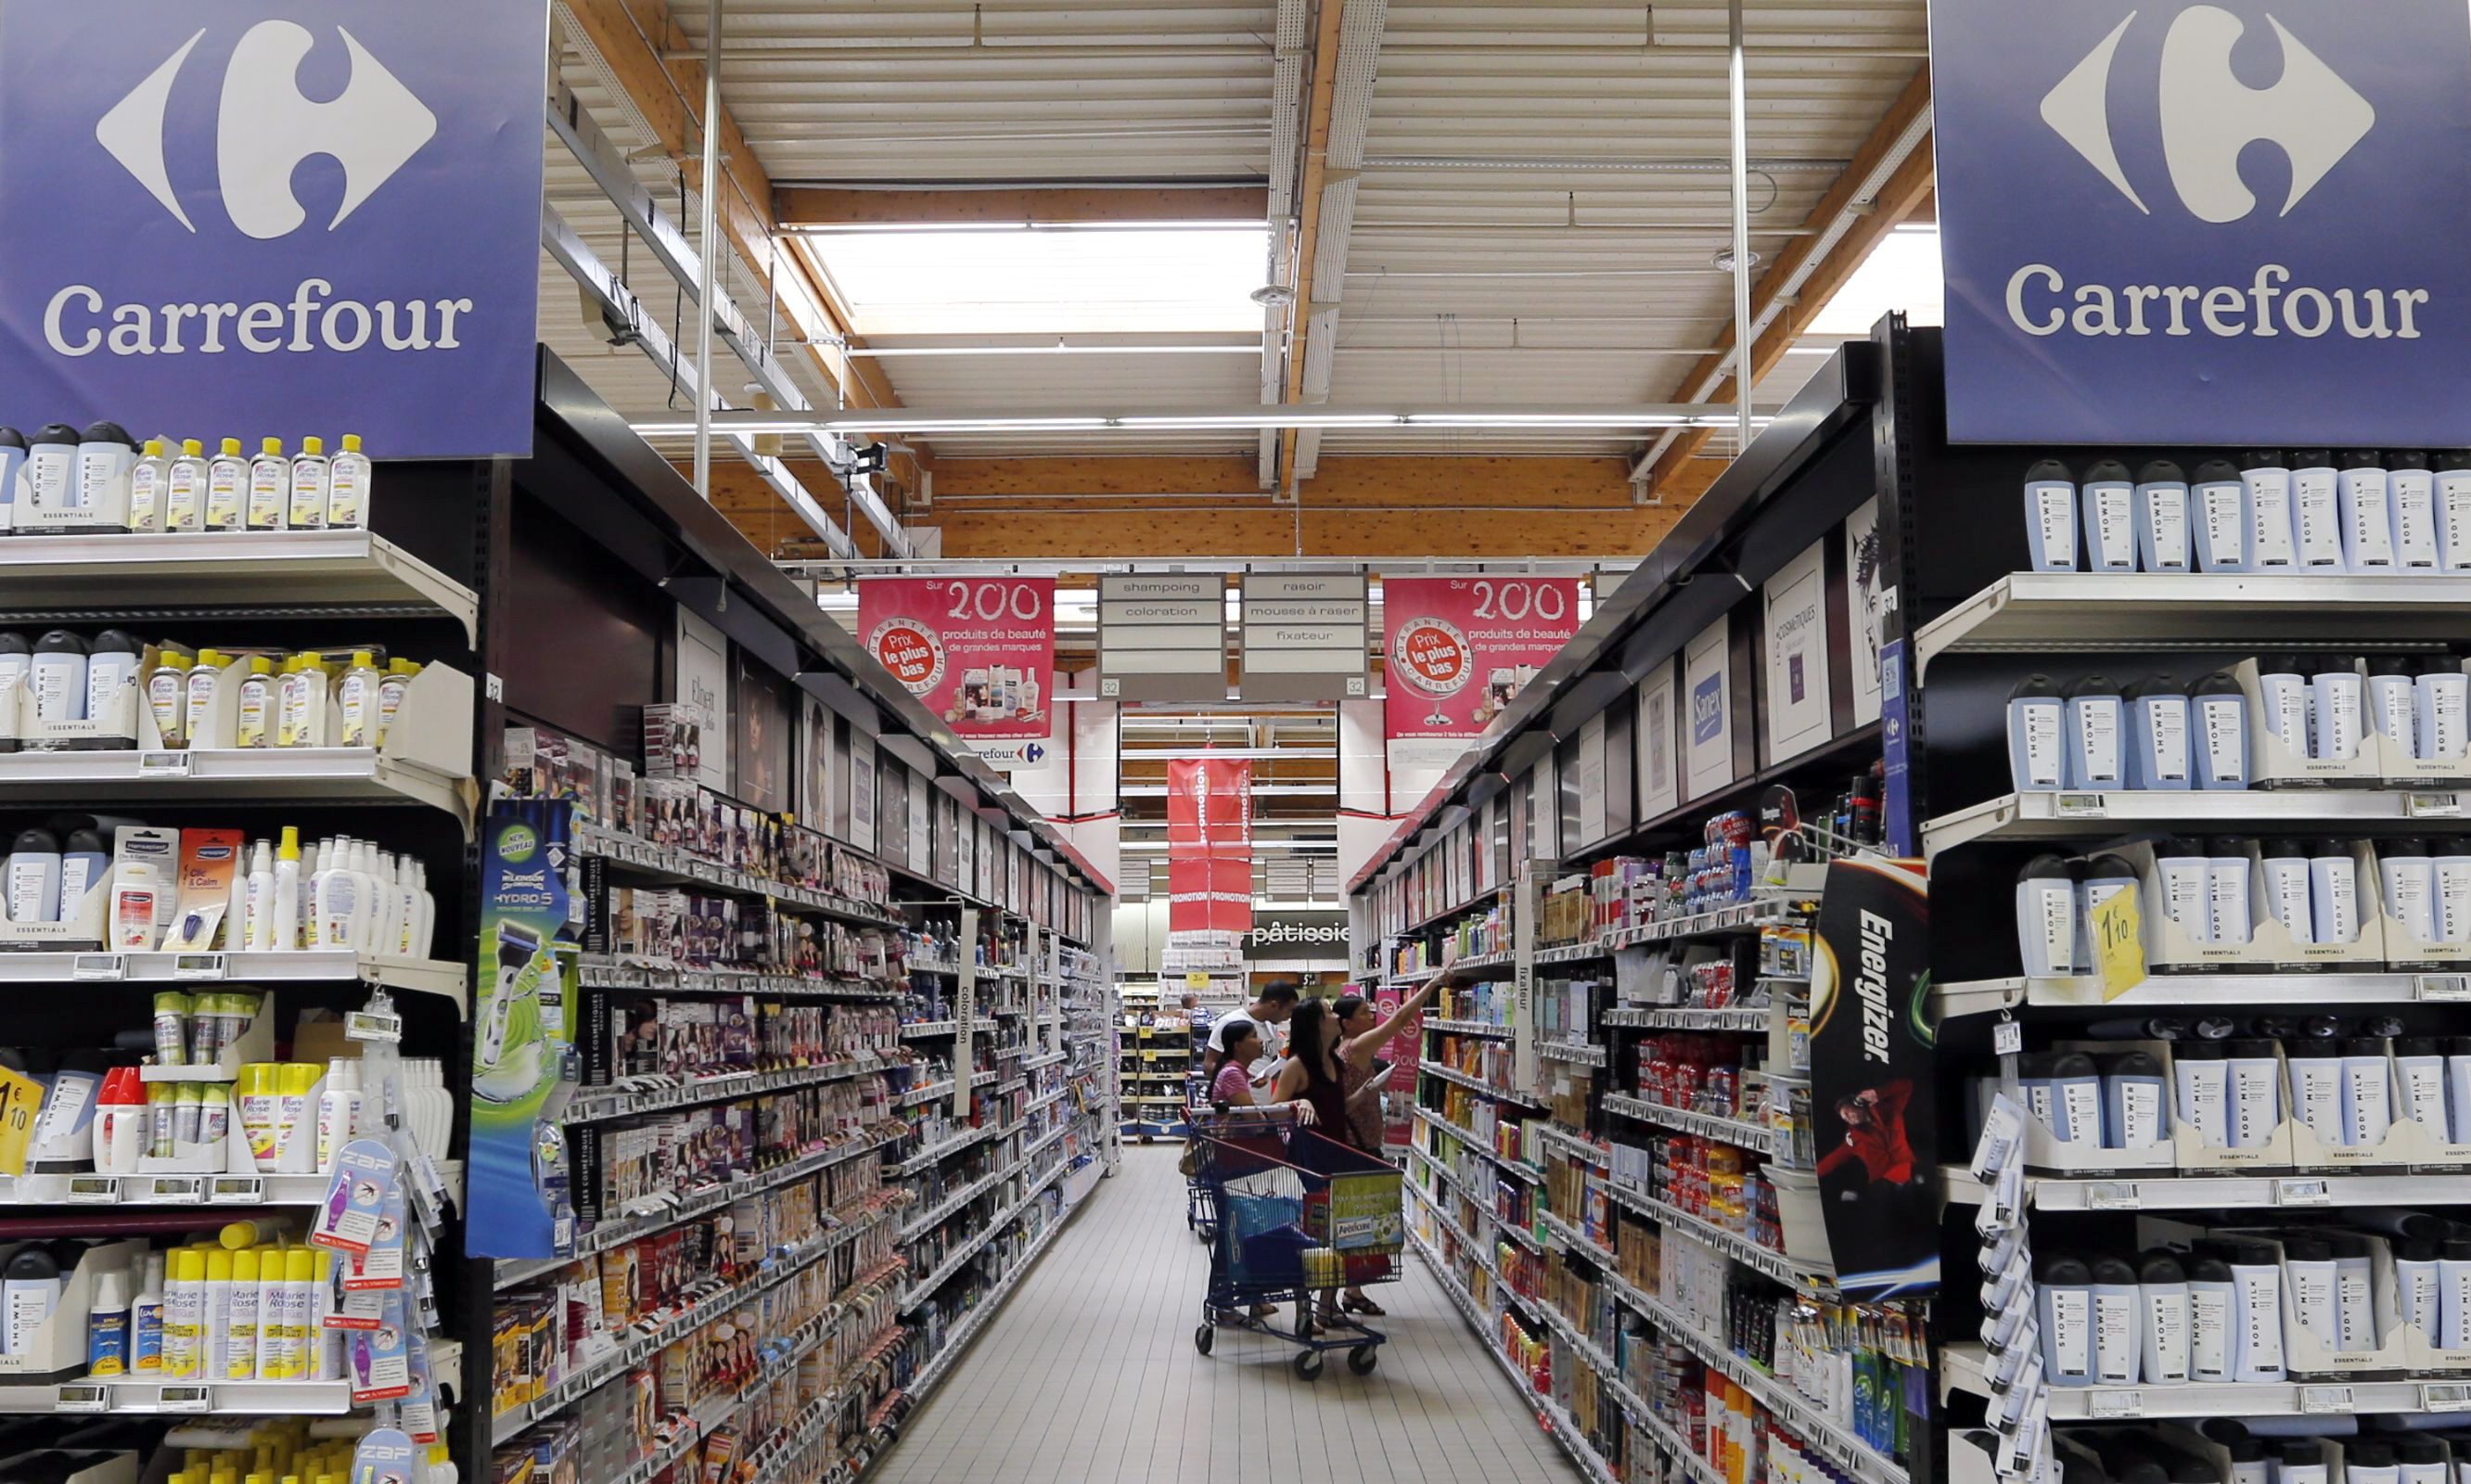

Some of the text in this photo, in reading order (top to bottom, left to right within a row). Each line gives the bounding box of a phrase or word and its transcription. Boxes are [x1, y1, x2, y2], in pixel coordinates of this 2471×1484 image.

[43, 277, 474, 357] Carrefour
[2005, 263, 2429, 339] Carrefour
[32, 456, 43, 505] SHOWER
[83, 456, 91, 505] SHOWER
[2042, 492, 2052, 540] SHOWER
[2100, 492, 2110, 541] SHOWER
[2154, 493, 2163, 542] SHOWER
[2209, 491, 2219, 540] SHOWER
[2254, 481, 2265, 544] BODY MILK
[2358, 514, 2367, 544] BODY
[2402, 516, 2411, 544] BODY
[2447, 484, 2459, 547] BODY MILK
[926, 581, 1041, 621] Sur 200
[1123, 582, 1200, 594] shampoing
[1283, 582, 1326, 592] rasoir
[1450, 581, 1565, 620] Sur 200
[1125, 607, 1197, 616] coloration
[1250, 605, 1359, 616] mousse à raser
[870, 619, 935, 653] GARANTIE
[888, 633, 915, 649] Prix
[942, 629, 1046, 642] produits de beauté
[963, 643, 1042, 654] grandes marques
[1276, 631, 1334, 640] fixateur
[1398, 618, 1460, 653] GARANTIE
[1412, 644, 1456, 664] le plus
[1415, 633, 1440, 647] Prix
[1468, 628, 1571, 641] produits de beauté
[1489, 642, 1527, 653] grandes
[884, 646, 929, 665] le plus
[900, 661, 926, 677] bas
[1406, 656, 1472, 692] CARREFOUR
[1428, 660, 1453, 676] bas
[1104, 683, 1117, 694] 32
[1349, 681, 1363, 692] 32
[1694, 686, 1722, 725] Sanex
[2029, 708, 2037, 759] SHOWER
[2085, 704, 2094, 755] SHOWER
[2154, 703, 2165, 753] SHOWER
[2209, 705, 2220, 755] SHOWER
[2334, 722, 2342, 751] BODY
[1196, 765, 1208, 844] promotion
[499, 840, 535, 855] NOUVEAU
[13, 866, 21, 916] SHOWER
[493, 892, 553, 905] HYDRO 5
[1171, 892, 1208, 903] PROMOTION
[1210, 890, 1250, 903] PROMOTION
[2441, 870, 2454, 935] BODY MILK
[2046, 892, 2055, 944] SHOWER
[2102, 911, 2113, 950] 1
[2115, 918, 2128, 942] 10
[1519, 966, 1529, 1011] fixateur
[1855, 908, 1893, 1066] Energizer
[960, 986, 970, 1044] coloration
[14, 1087, 22, 1102] €
[45, 1079, 67, 1127] SHOWER
[2354, 1072, 2366, 1139] BODY MILK
[11, 1106, 27, 1131] 10
[2068, 1089, 2080, 1140] SHOWER
[2056, 1294, 2066, 1347] SHOWER
[2096, 1298, 2106, 1350] SHOWER
[2156, 1298, 2166, 1350] SHOWER
[2191, 1294, 2200, 1347] SHOWER
